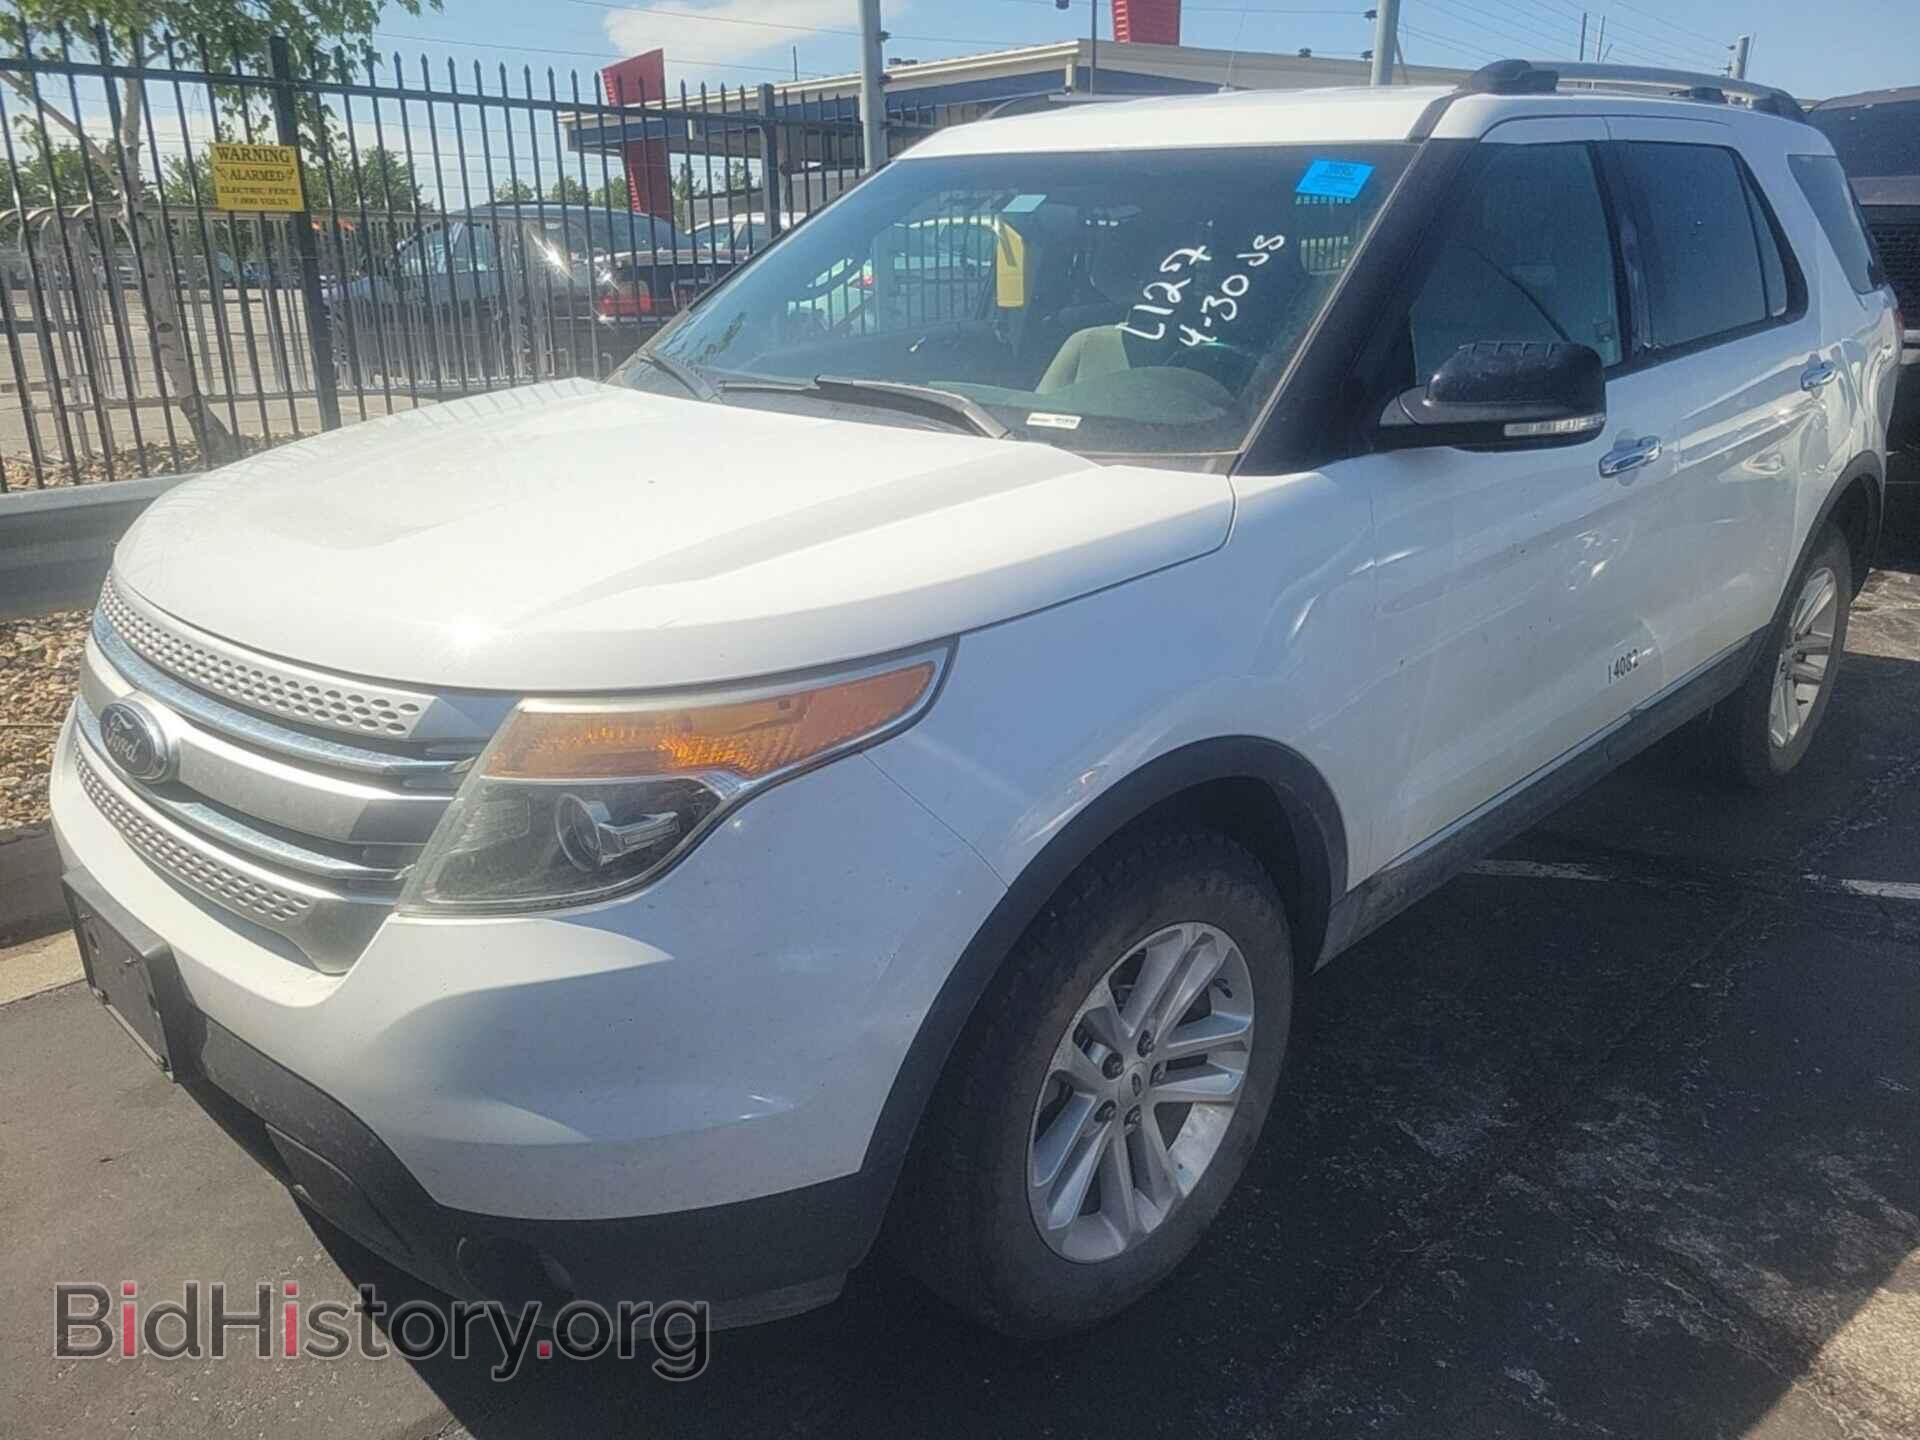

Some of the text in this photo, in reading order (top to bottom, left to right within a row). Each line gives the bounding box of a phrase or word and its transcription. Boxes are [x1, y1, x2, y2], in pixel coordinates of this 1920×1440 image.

[215, 146, 290, 162] WARNING
[229, 169, 286, 182] ALARMED
[107, 711, 141, 763] Ford
